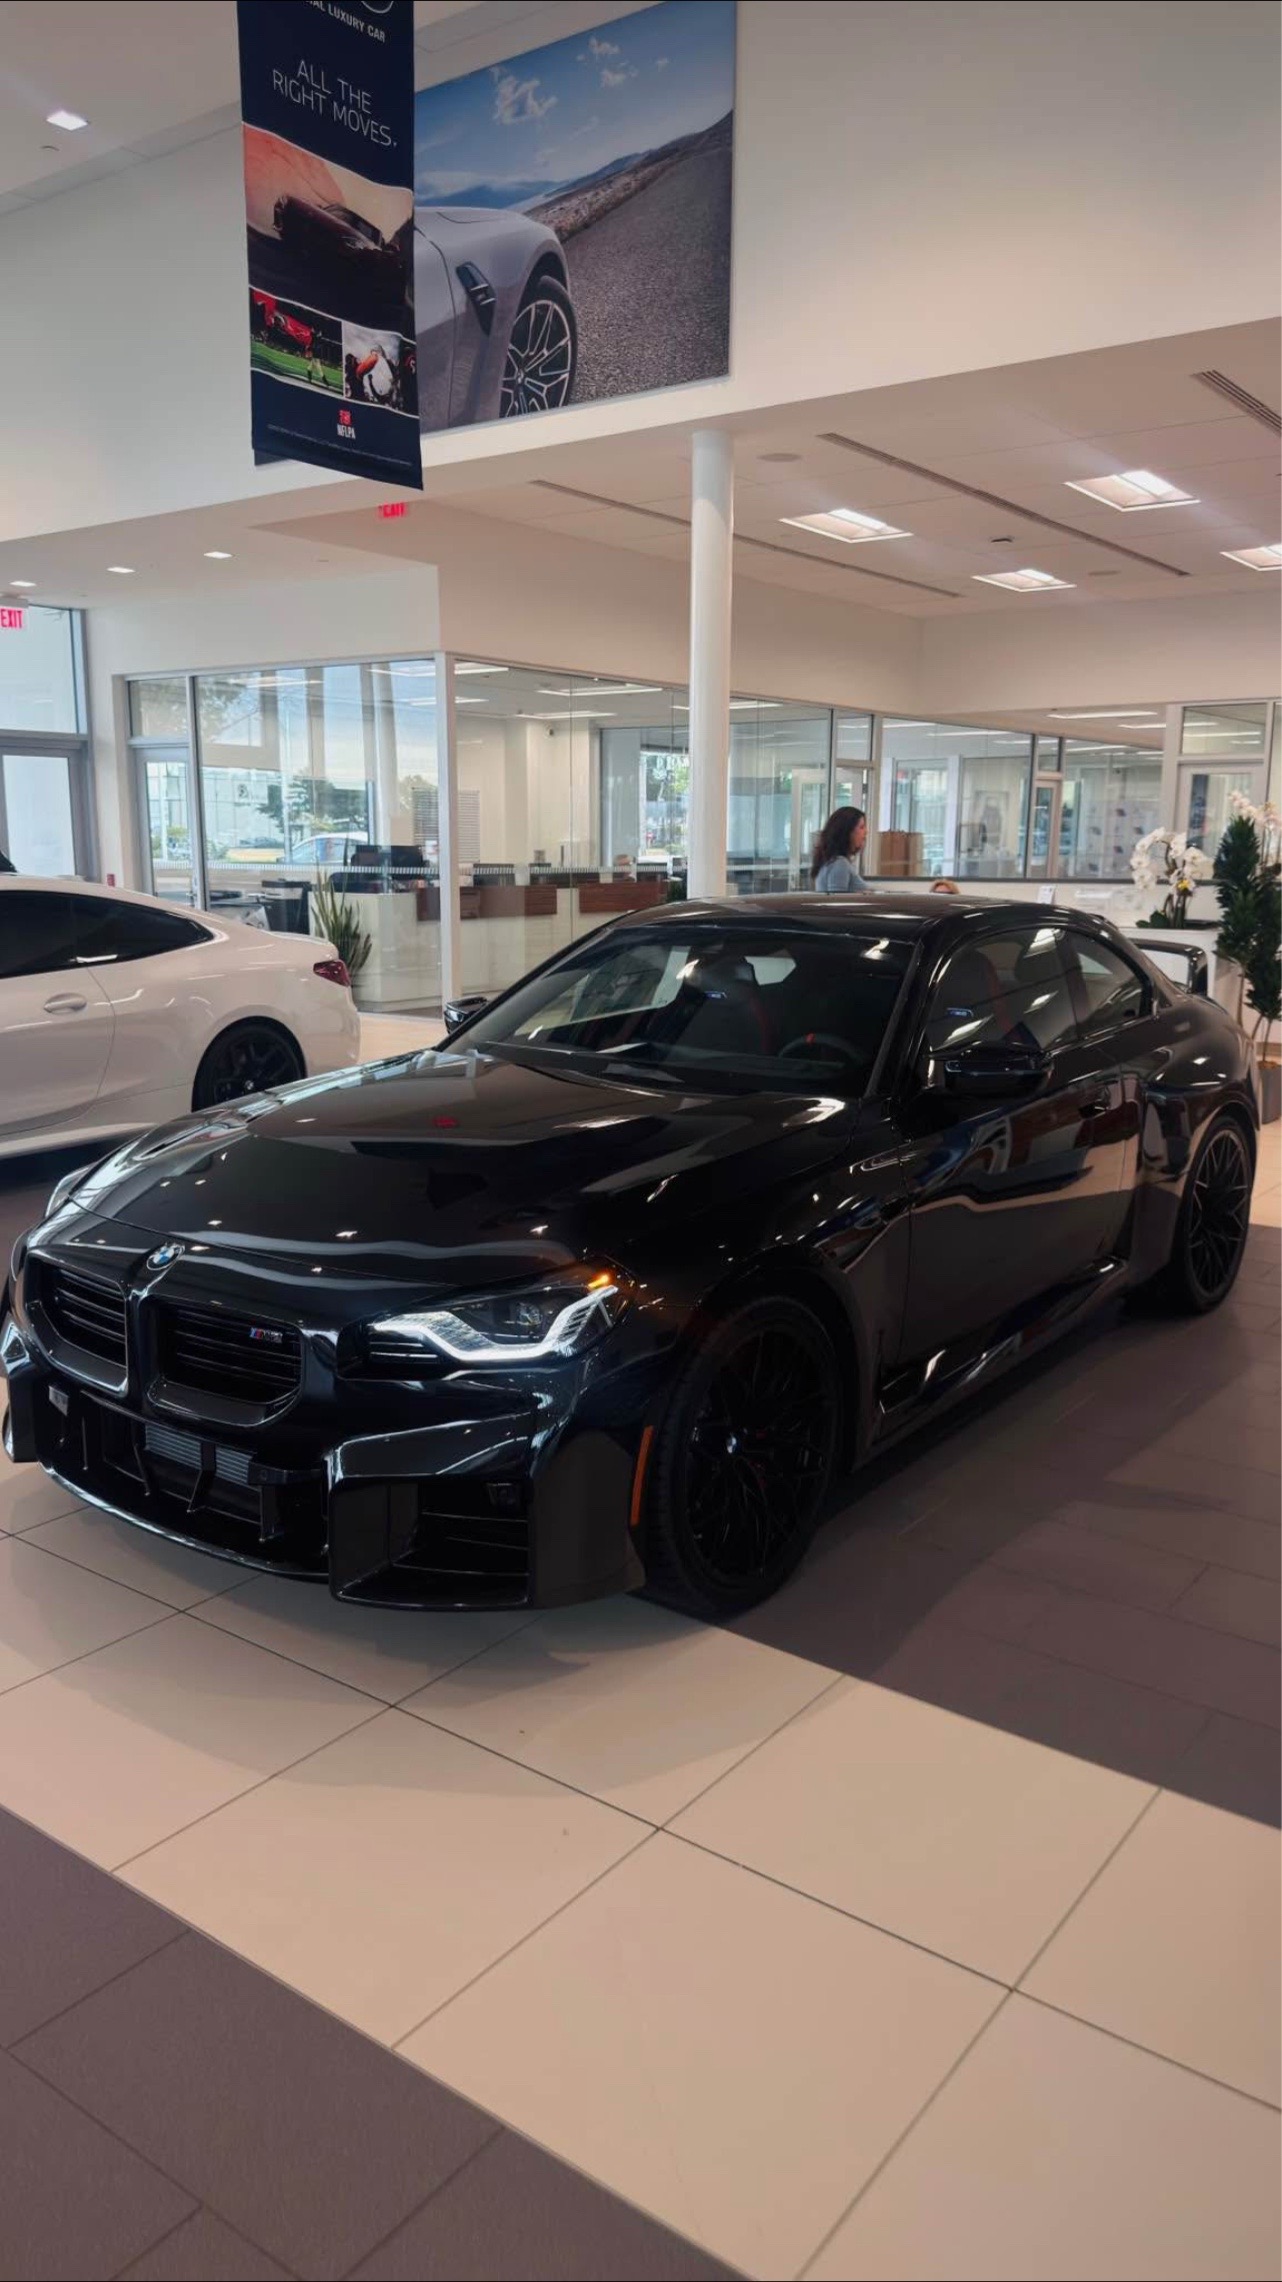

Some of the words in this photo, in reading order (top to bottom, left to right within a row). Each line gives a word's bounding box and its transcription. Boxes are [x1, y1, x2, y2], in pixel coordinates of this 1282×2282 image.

[328, 3, 365, 32] LUXURY
[367, 25, 386, 43] CAR
[272, 68, 327, 115] RIGHT
[333, 101, 398, 147] MOVES.
[297, 60, 332, 94] ALL
[337, 78, 372, 115] THE
[337, 424, 356, 439] NFLPA
[1, 608, 23, 629] EXIT
